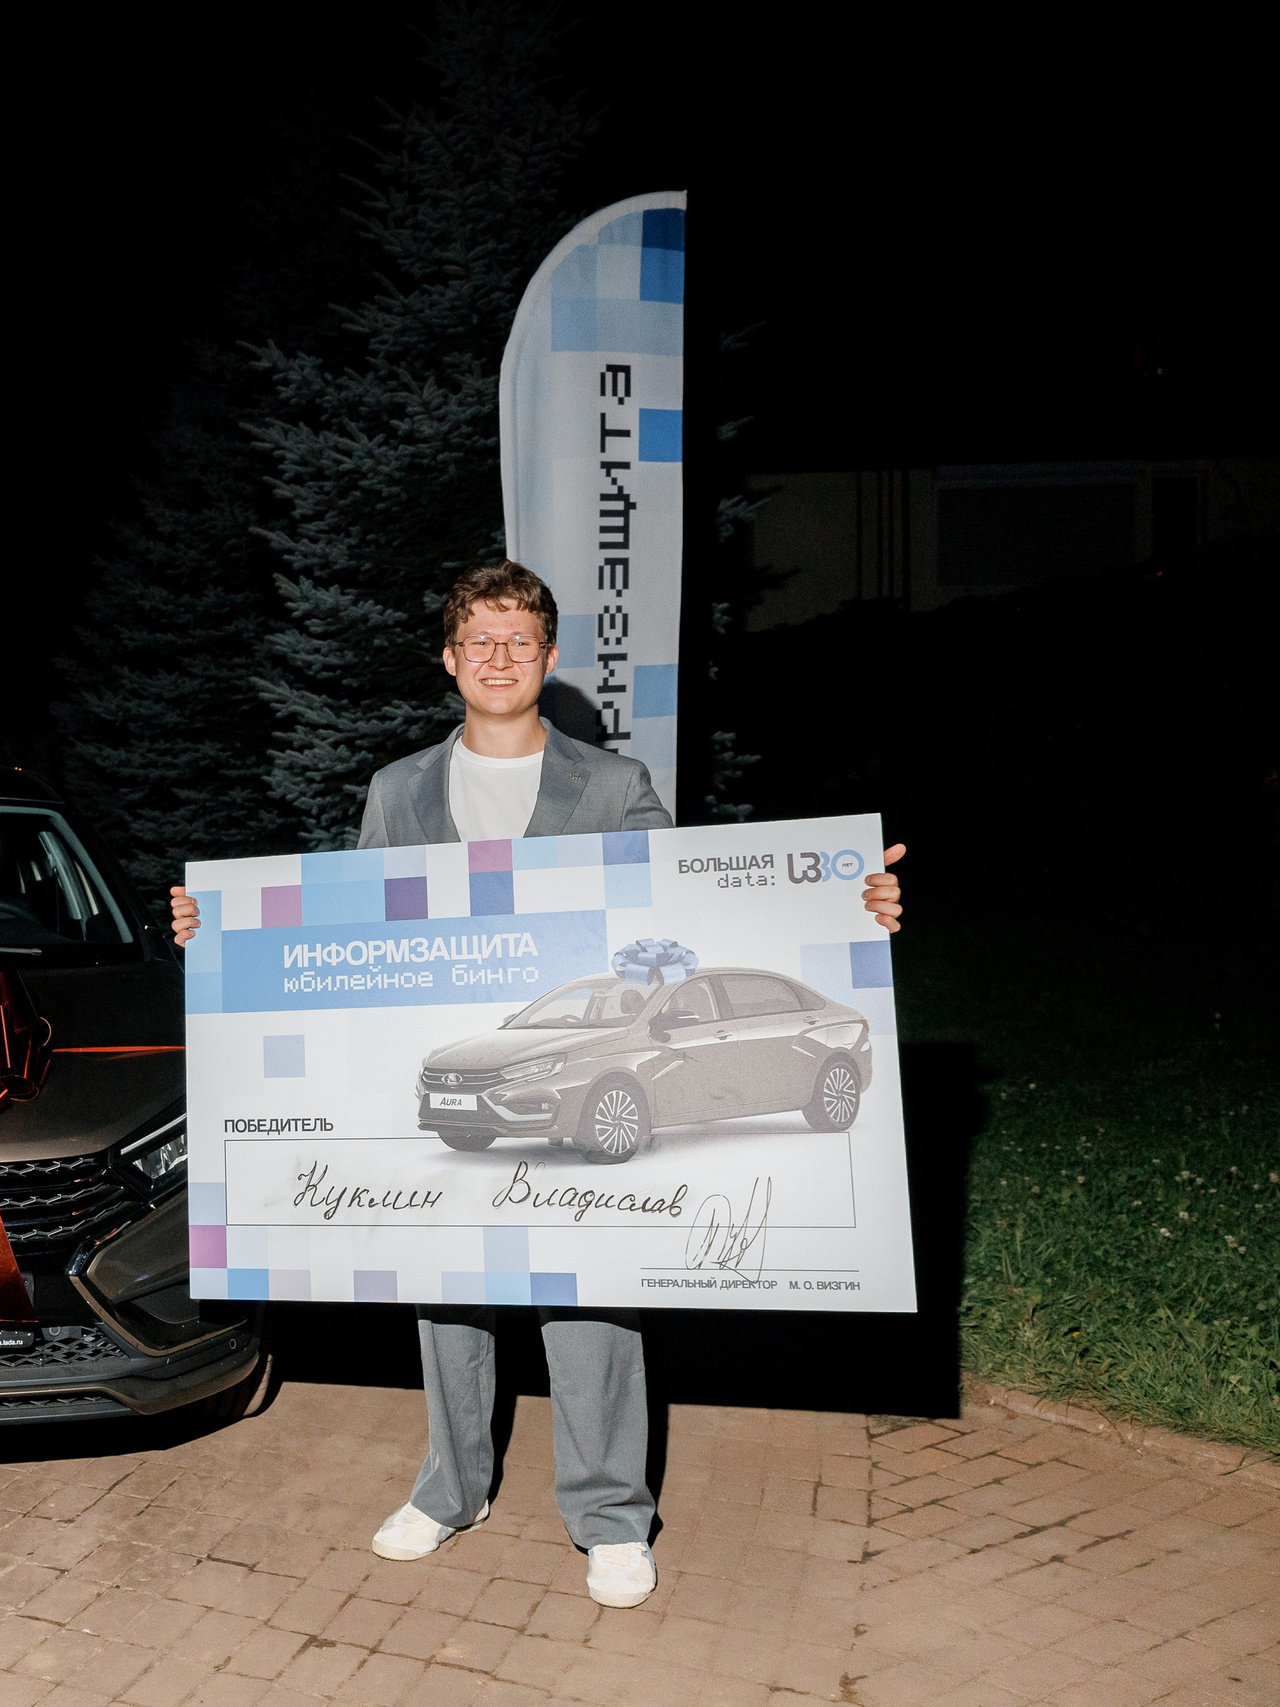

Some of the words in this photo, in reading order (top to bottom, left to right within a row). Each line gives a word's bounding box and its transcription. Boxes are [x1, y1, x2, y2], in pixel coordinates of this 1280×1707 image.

[678, 854, 774, 874] БОЛЬШАЯ
[717, 872, 775, 888] data:
[283, 932, 539, 968] ИНФОРМЗАЩИТА
[284, 965, 434, 993] юбилейное
[452, 964, 539, 986] бинго
[224, 1118, 334, 1135] ПОБЕДИТЕЛЬ
[492, 1160, 688, 1222] Владислав
[641, 1277, 717, 1289] ГЕНЕРАЛЬНЫЙ
[720, 1279, 778, 1290] ДИРЕКТОР
[817, 1281, 861, 1291] ВИЗГИН
